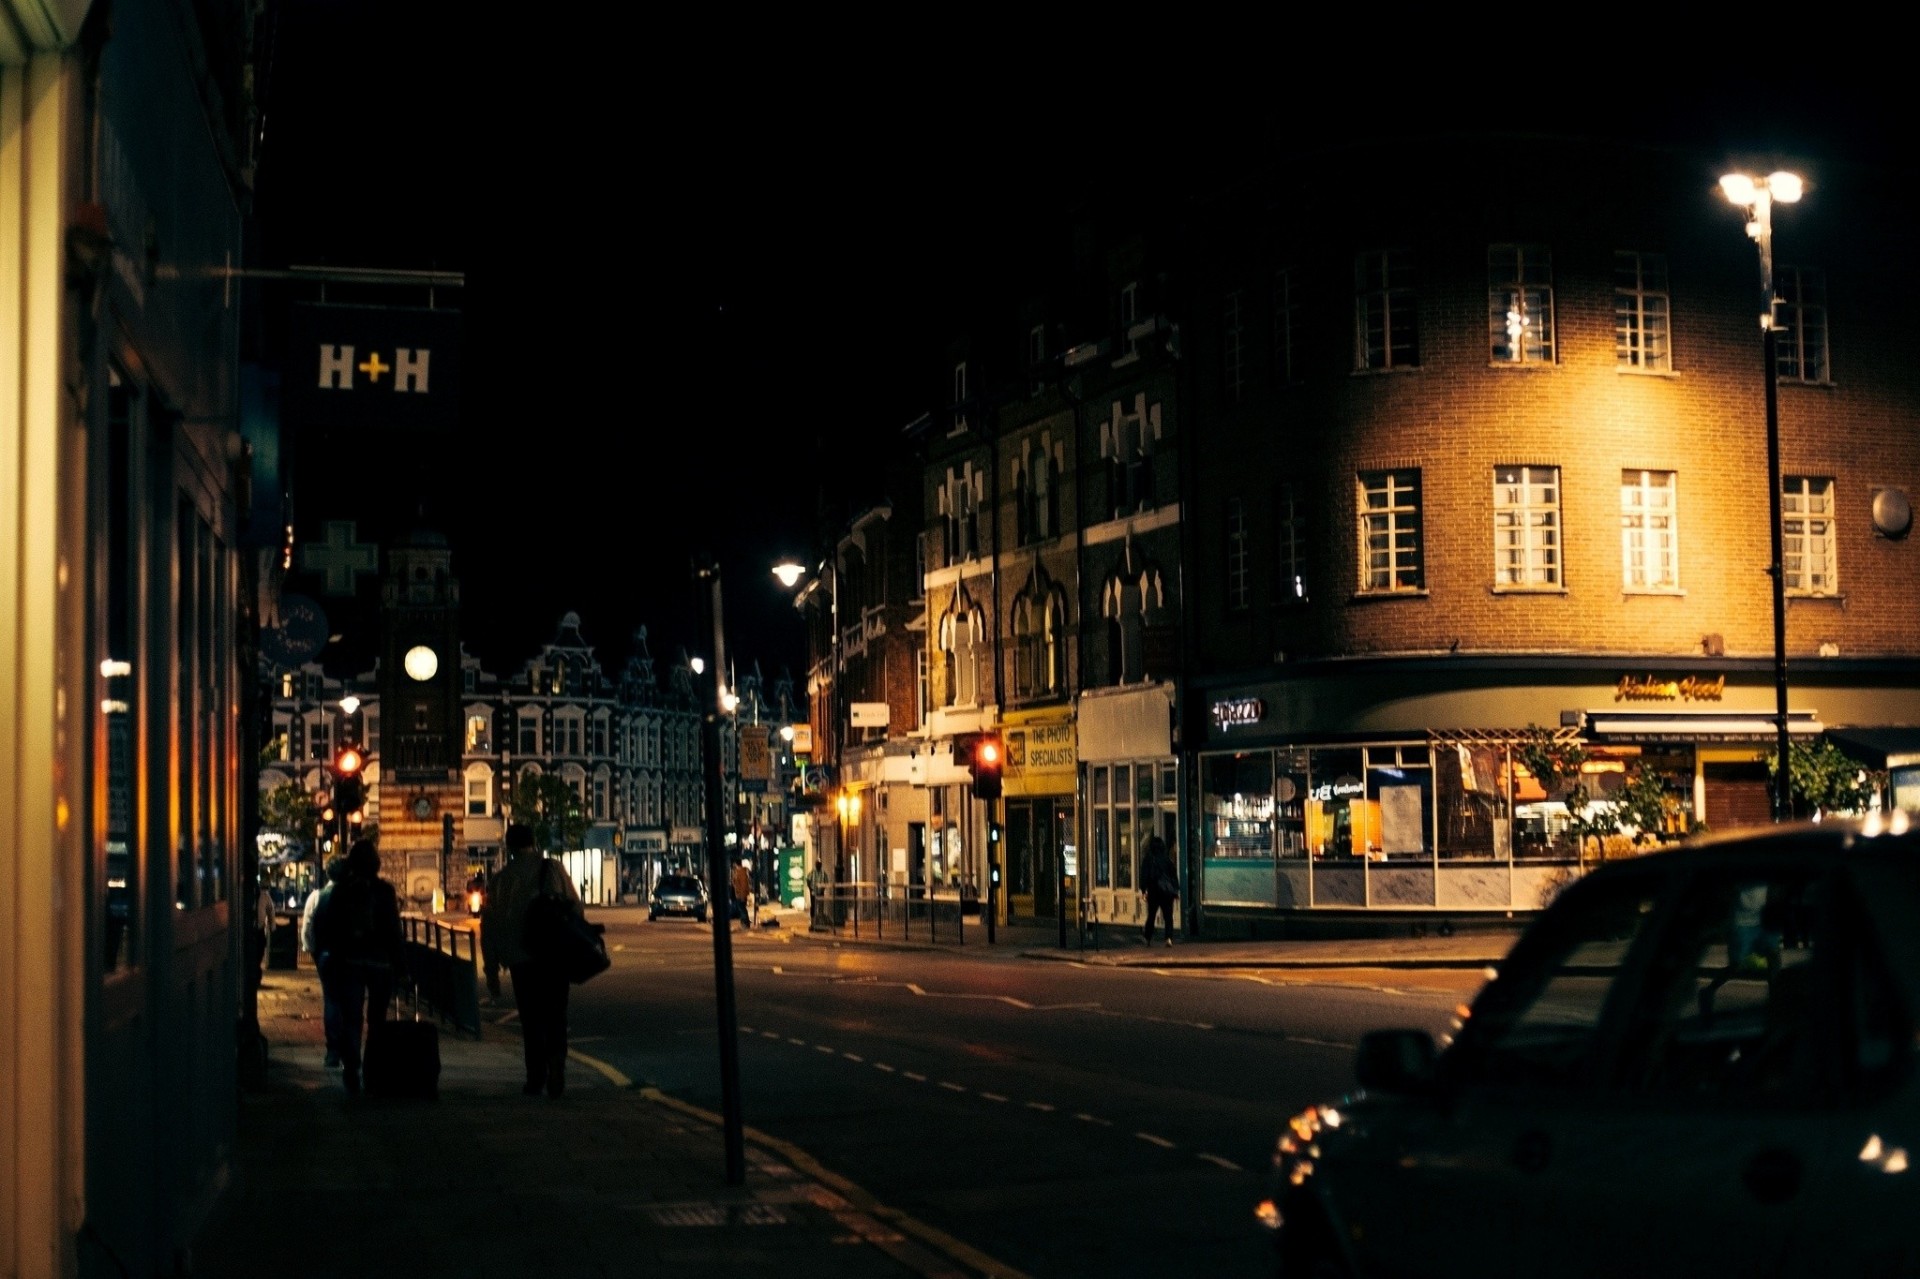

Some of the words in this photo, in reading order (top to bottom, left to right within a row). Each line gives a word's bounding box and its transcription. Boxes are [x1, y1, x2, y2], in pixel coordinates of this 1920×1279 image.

[318, 343, 431, 394] H+H
[1032, 728, 1045, 745] THE
[1047, 725, 1070, 744] PHOTO
[1030, 747, 1074, 767] SPECIALISTS
